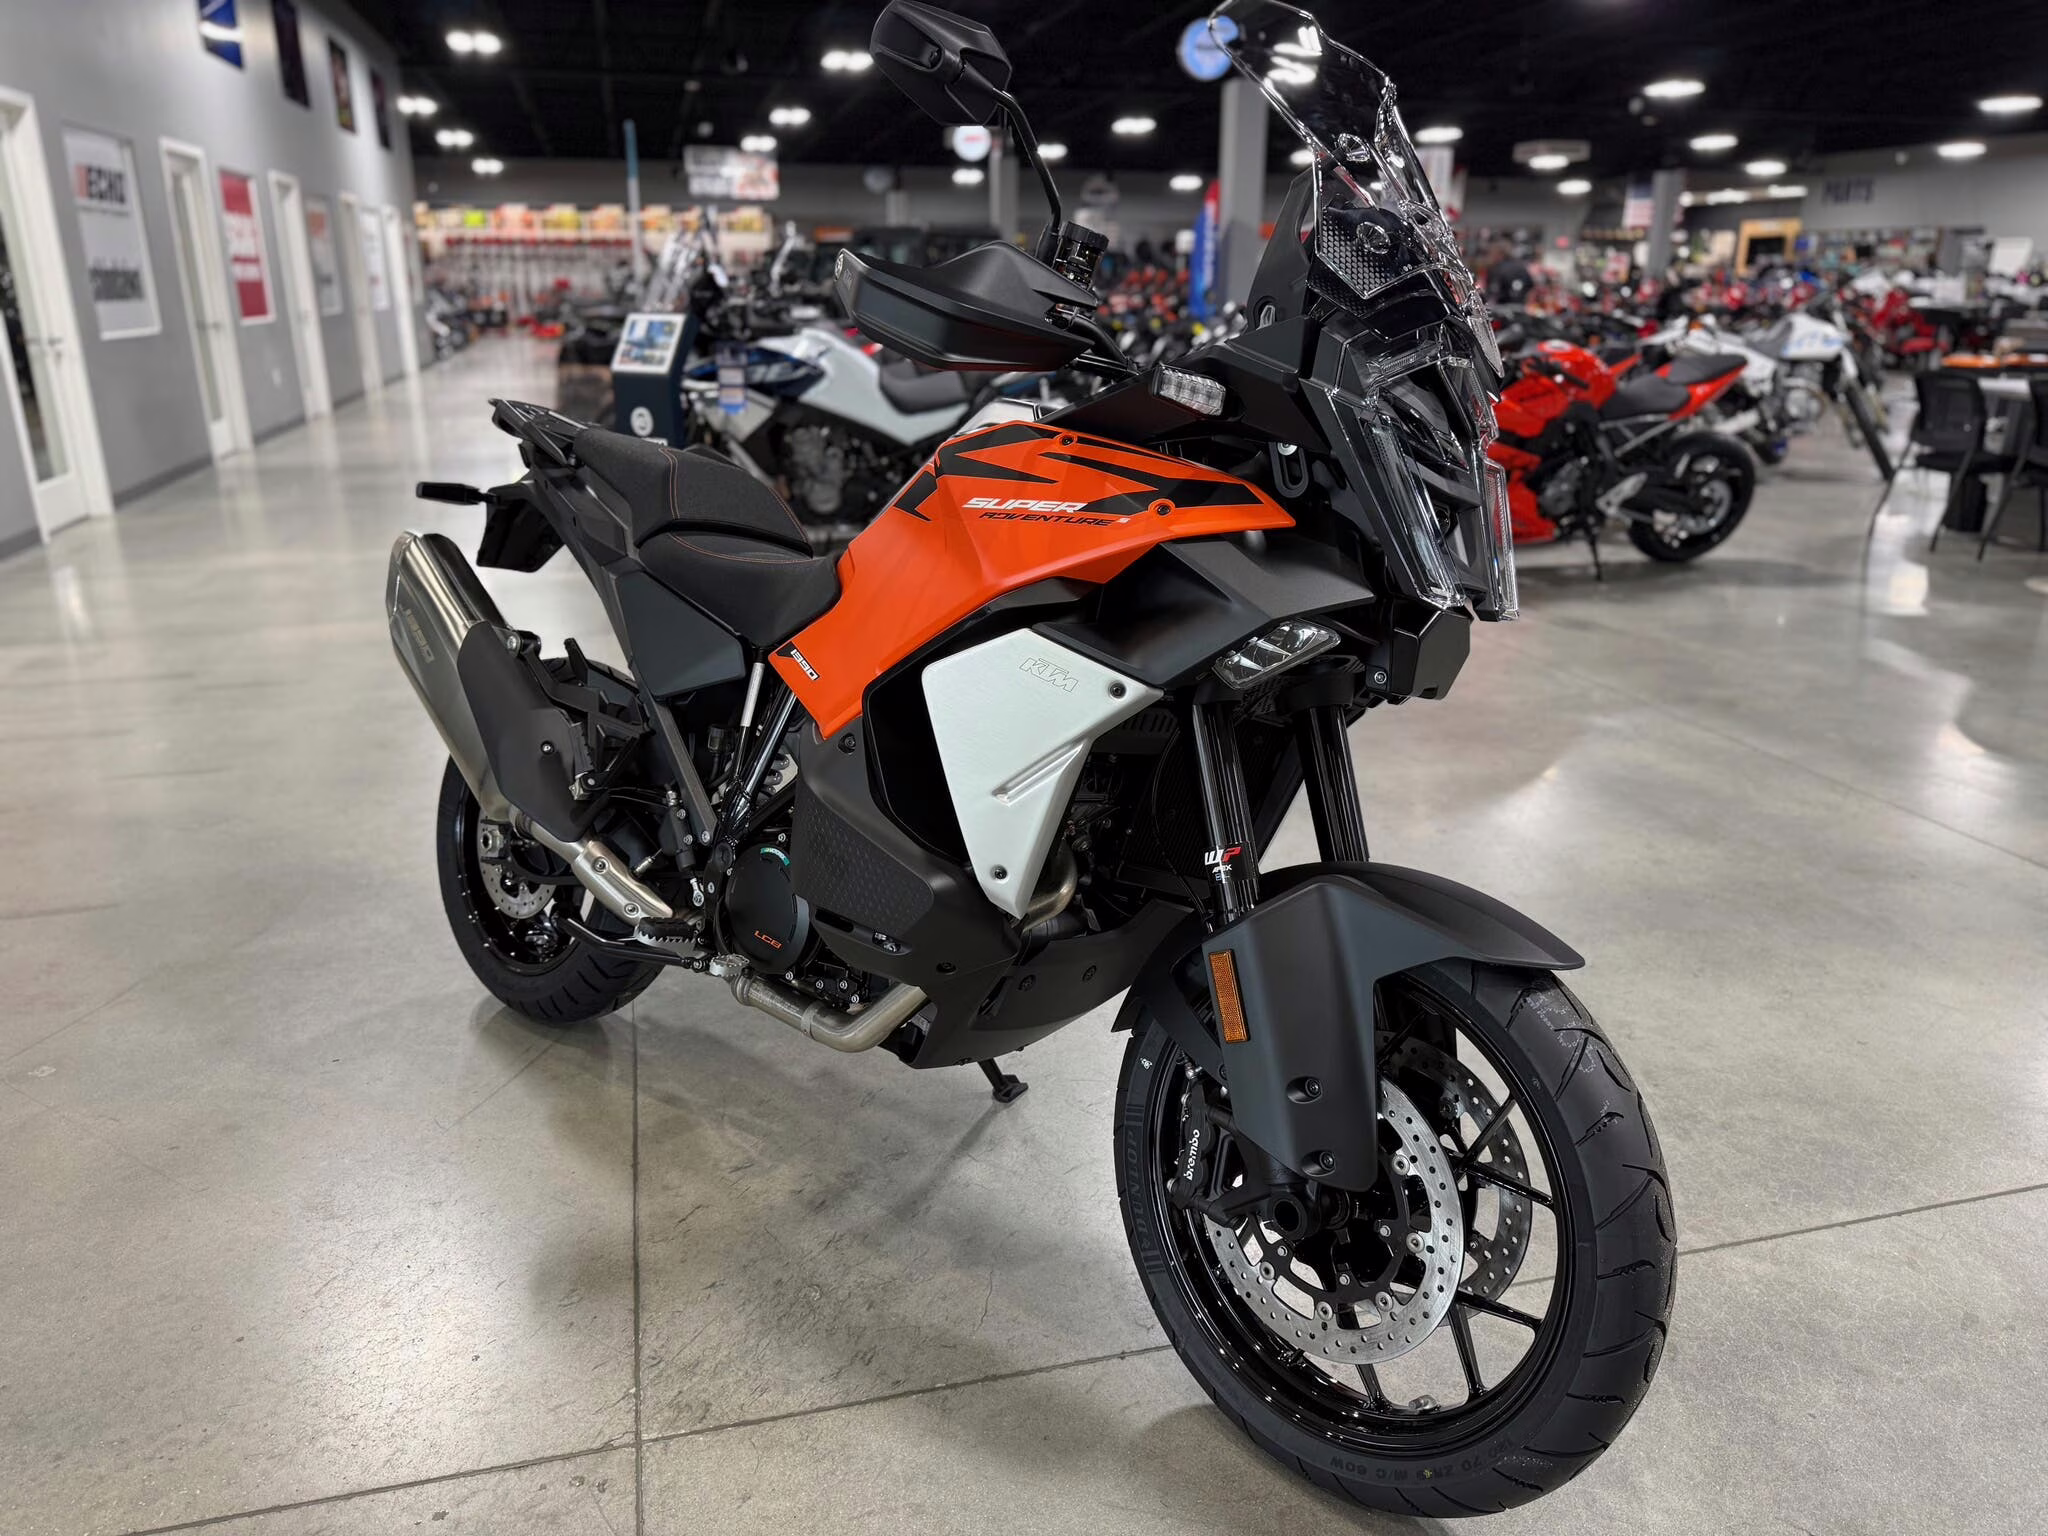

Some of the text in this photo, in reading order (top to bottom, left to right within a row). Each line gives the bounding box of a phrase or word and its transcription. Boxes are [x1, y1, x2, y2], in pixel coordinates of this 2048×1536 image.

[962, 497, 1088, 514] SUPER
[979, 512, 1115, 526] ADVENTURE
[1019, 656, 1079, 693] KTM
[1204, 846, 1242, 866] WP
[754, 930, 782, 949] LC8
[1183, 1128, 1200, 1181] brembo
